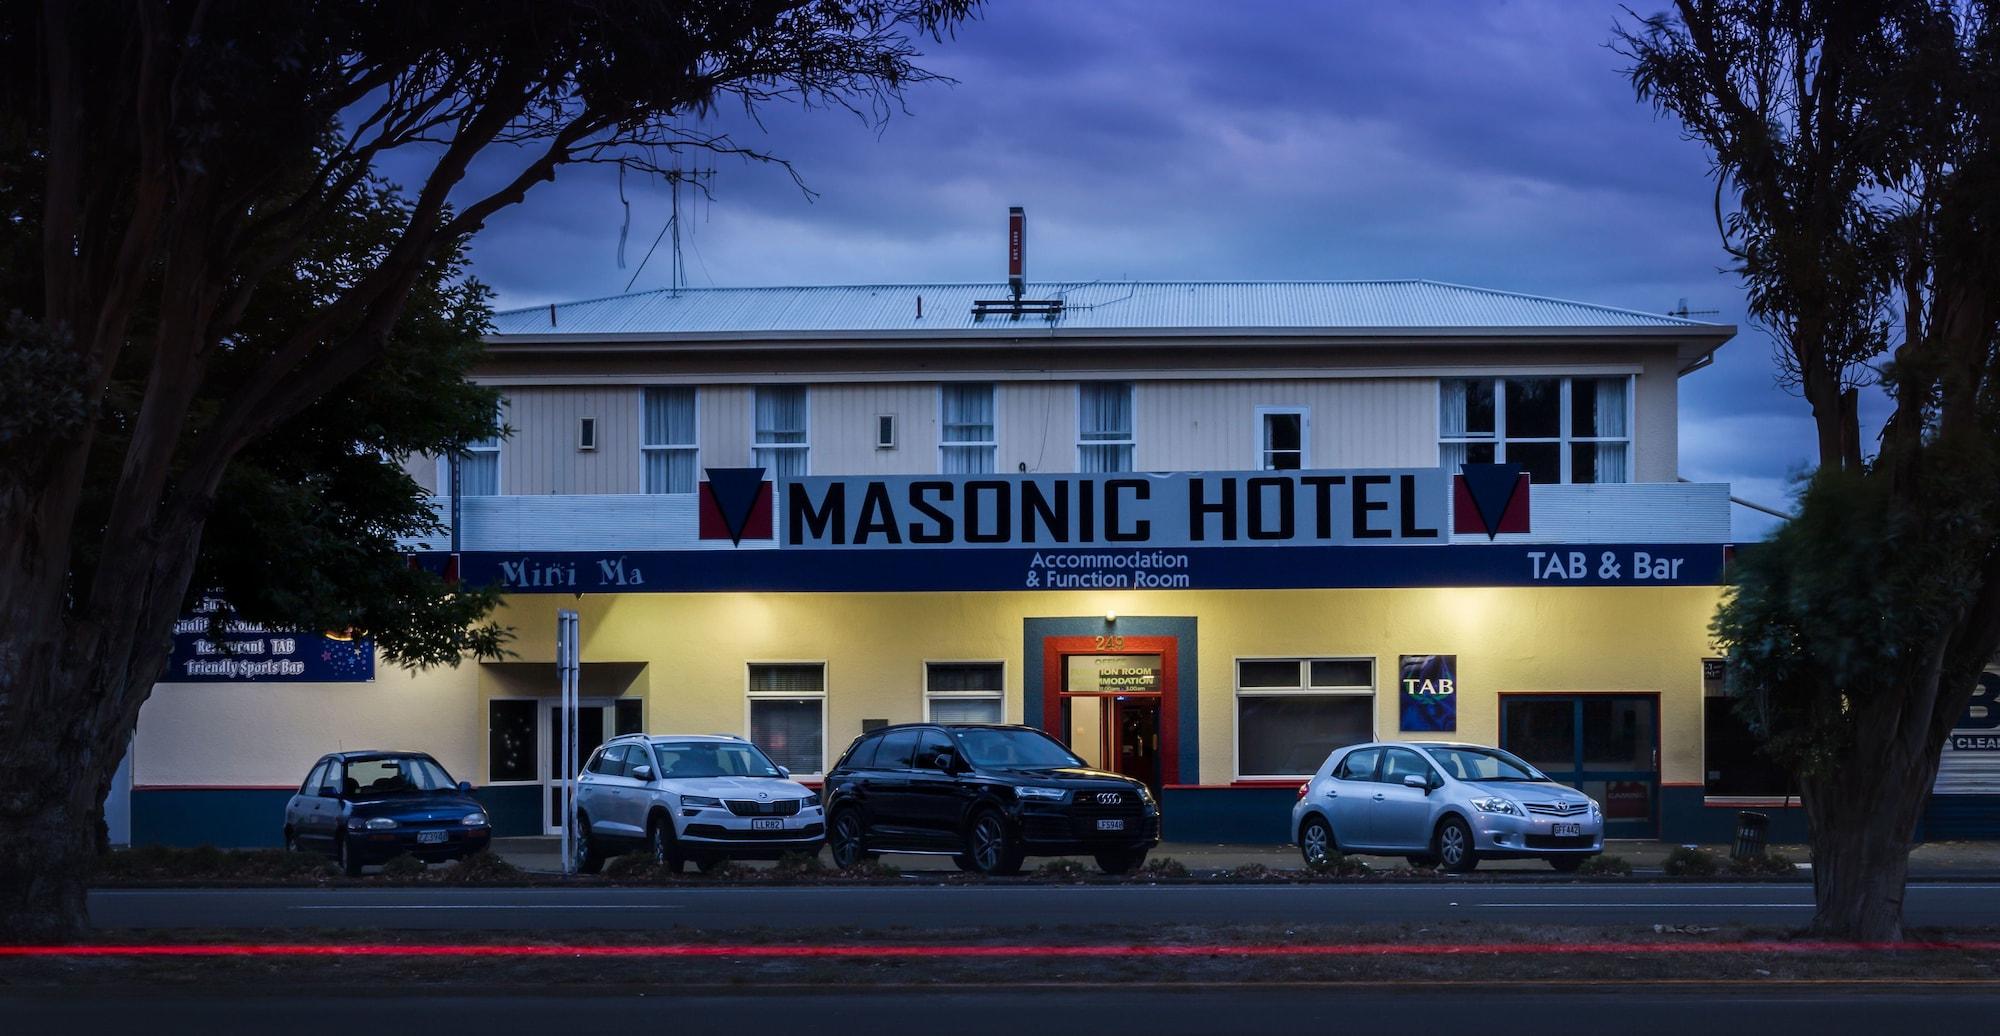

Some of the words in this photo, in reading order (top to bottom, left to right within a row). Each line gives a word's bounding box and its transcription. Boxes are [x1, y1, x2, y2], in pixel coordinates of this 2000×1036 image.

[789, 479, 1150, 545] MASONIC
[1189, 475, 1438, 541] HOTEL
[1030, 551, 1188, 568] Accommodation
[1527, 551, 1588, 580] TAB
[1598, 551, 1621, 580] &
[1634, 551, 1684, 580] Bar
[499, 557, 577, 588] Mini
[597, 555, 645, 586] Ma
[1026, 571, 1040, 587] &
[1047, 570, 1128, 588] Function
[1134, 570, 1190, 588] Room
[270, 638, 296, 655] TAB
[184, 659, 238, 678] Friendly
[239, 660, 279, 678] Sports
[279, 660, 305, 677] Bar
[1121, 667, 1152, 676] ROOM
[1402, 678, 1455, 696] TAB
[1956, 737, 2000, 749] CLEA
